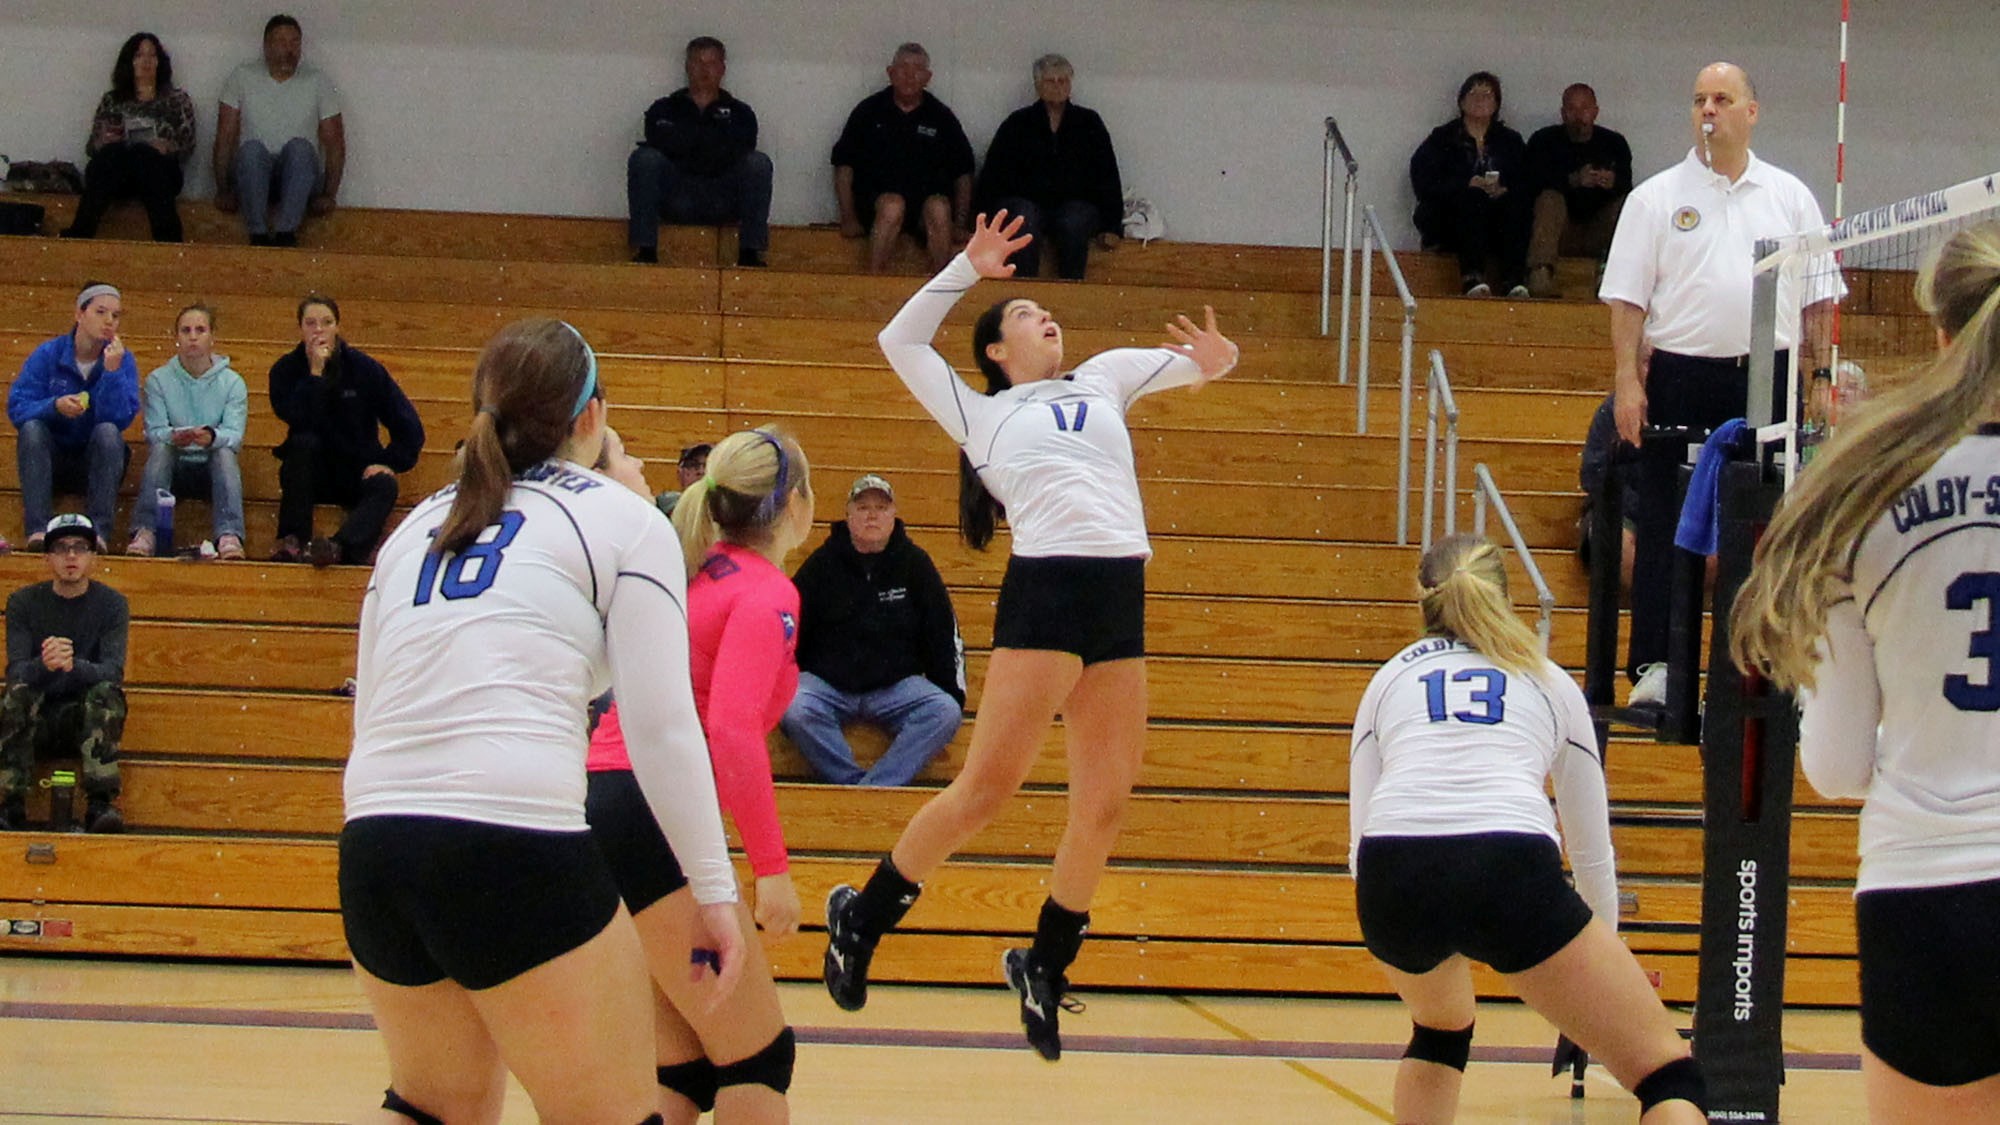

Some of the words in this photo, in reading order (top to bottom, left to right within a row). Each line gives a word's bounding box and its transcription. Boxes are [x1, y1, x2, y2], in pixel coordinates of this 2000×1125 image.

[1046, 401, 1088, 432] 17
[413, 509, 526, 606] 18
[1418, 667, 1507, 725] 13
[1736, 859, 1758, 930] sports
[1732, 934, 1754, 1021] imports
